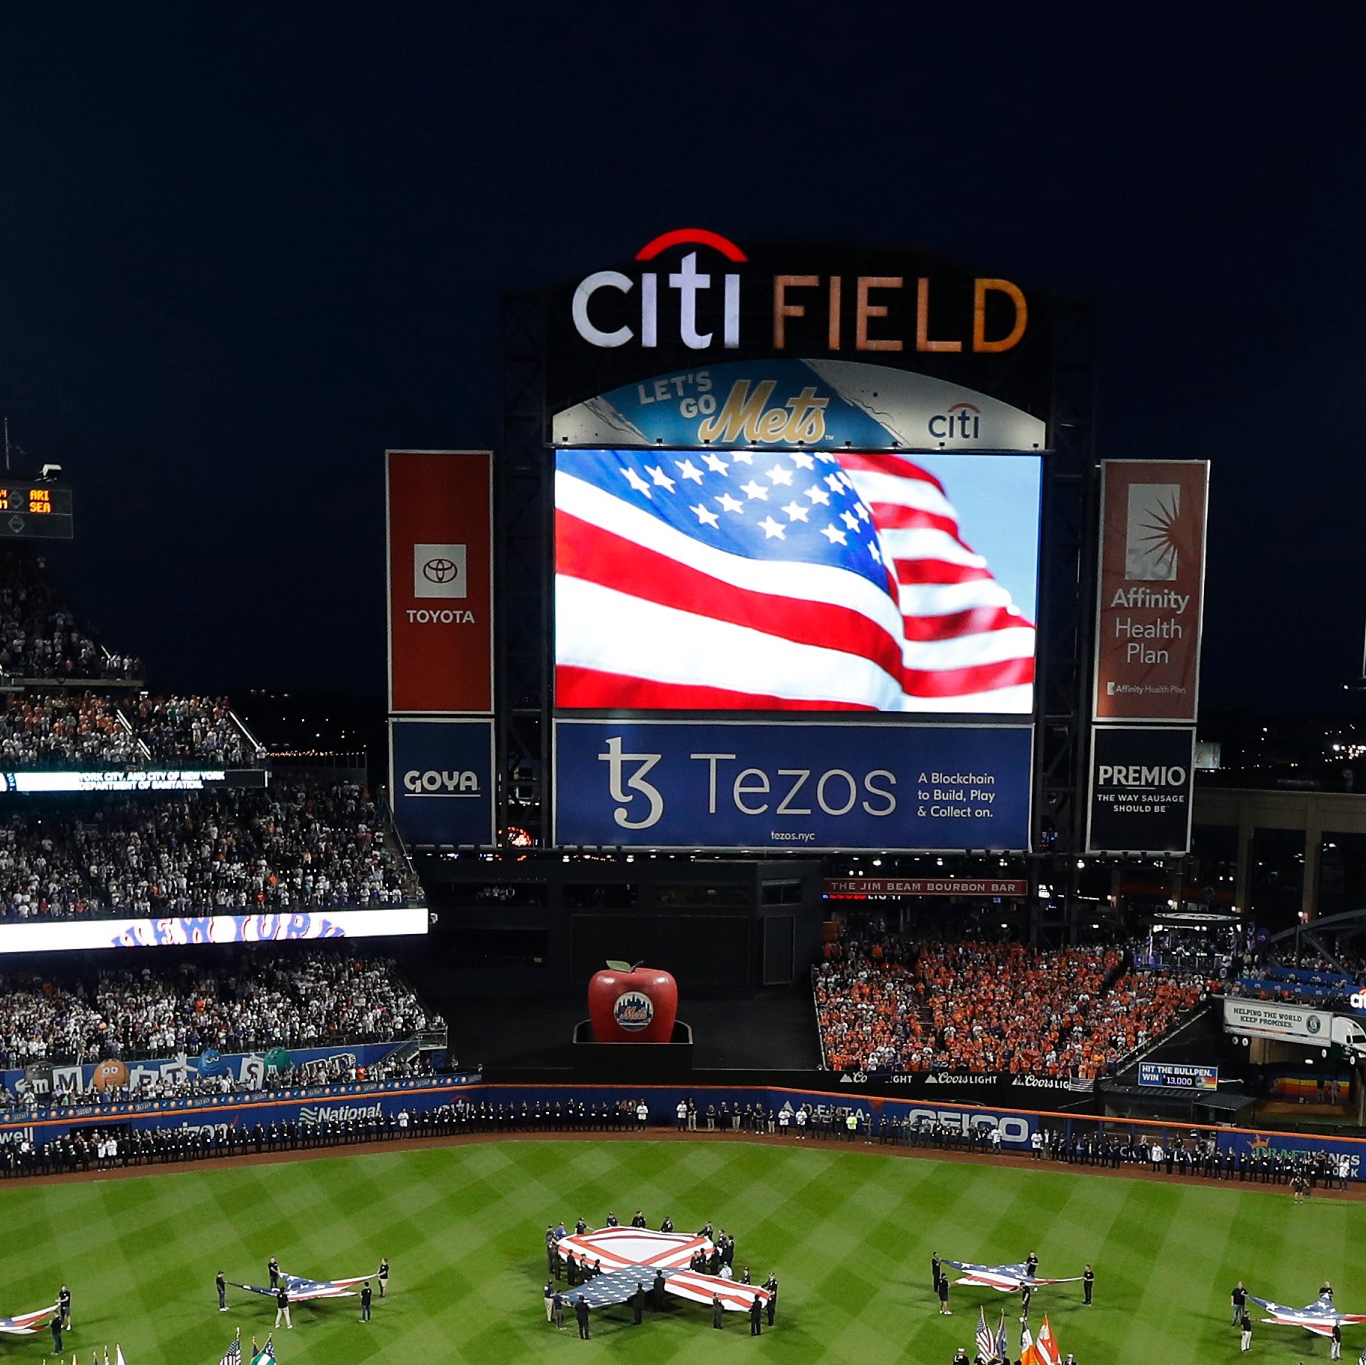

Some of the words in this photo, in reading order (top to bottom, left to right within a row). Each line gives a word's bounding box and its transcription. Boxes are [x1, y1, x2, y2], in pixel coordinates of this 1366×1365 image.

[572, 251, 739, 349] citi
[773, 275, 1027, 352] FIELD
[637, 370, 712, 404] LET'S
[680, 393, 717, 419] GO
[698, 379, 829, 443] Mets
[928, 408, 980, 439] citi
[1110, 587, 1190, 615] Affinity
[406, 609, 476, 624] TOYOTA
[1115, 617, 1182, 639] Health
[1126, 642, 1170, 665] Plan
[1116, 684, 1144, 695] Affinity
[403, 770, 478, 793] GOYA
[918, 773, 929, 784] A
[931, 772, 995, 785] Blockchain
[1098, 764, 1186, 786] PREMIO
[690, 752, 897, 816] Tezos
[918, 790, 930, 801] to
[933, 789, 966, 804] Build,
[970, 789, 996, 805] Play
[1097, 794, 1116, 803] THE
[1118, 794, 1139, 803] WAY
[1141, 794, 1185, 803] SAUSAGE
[917, 806, 927, 818] &
[930, 805, 967, 818] Collect
[970, 807, 994, 818] on.
[1113, 804, 1152, 813] SHOULD
[1154, 805, 1166, 813] BE
[771, 830, 816, 843] tezos.nyc
[831, 882, 856, 892] THE
[859, 882, 882, 892] JIM
[886, 882, 921, 892] BEAM
[927, 882, 986, 892] BOURBON
[991, 883, 1016, 892] BAR
[1233, 1007, 1255, 1019] HELPING
[1256, 1010, 1269, 1019] THE
[1271, 1012, 1303, 1023] WORLD
[1240, 1016, 1255, 1026] KEEP
[1256, 1018, 1293, 1029] PROMISES.
[937, 1071, 968, 1086] Coors
[969, 1074, 998, 1085] LIGHT
[1142, 1064, 1156, 1074] HIT
[1157, 1066, 1174, 1075] THE
[1175, 1066, 1213, 1077] BULLPEN.
[1142, 1073, 1159, 1082] WIN
[1025, 1074, 1053, 1089] Coors
[319, 1102, 381, 1124] National
